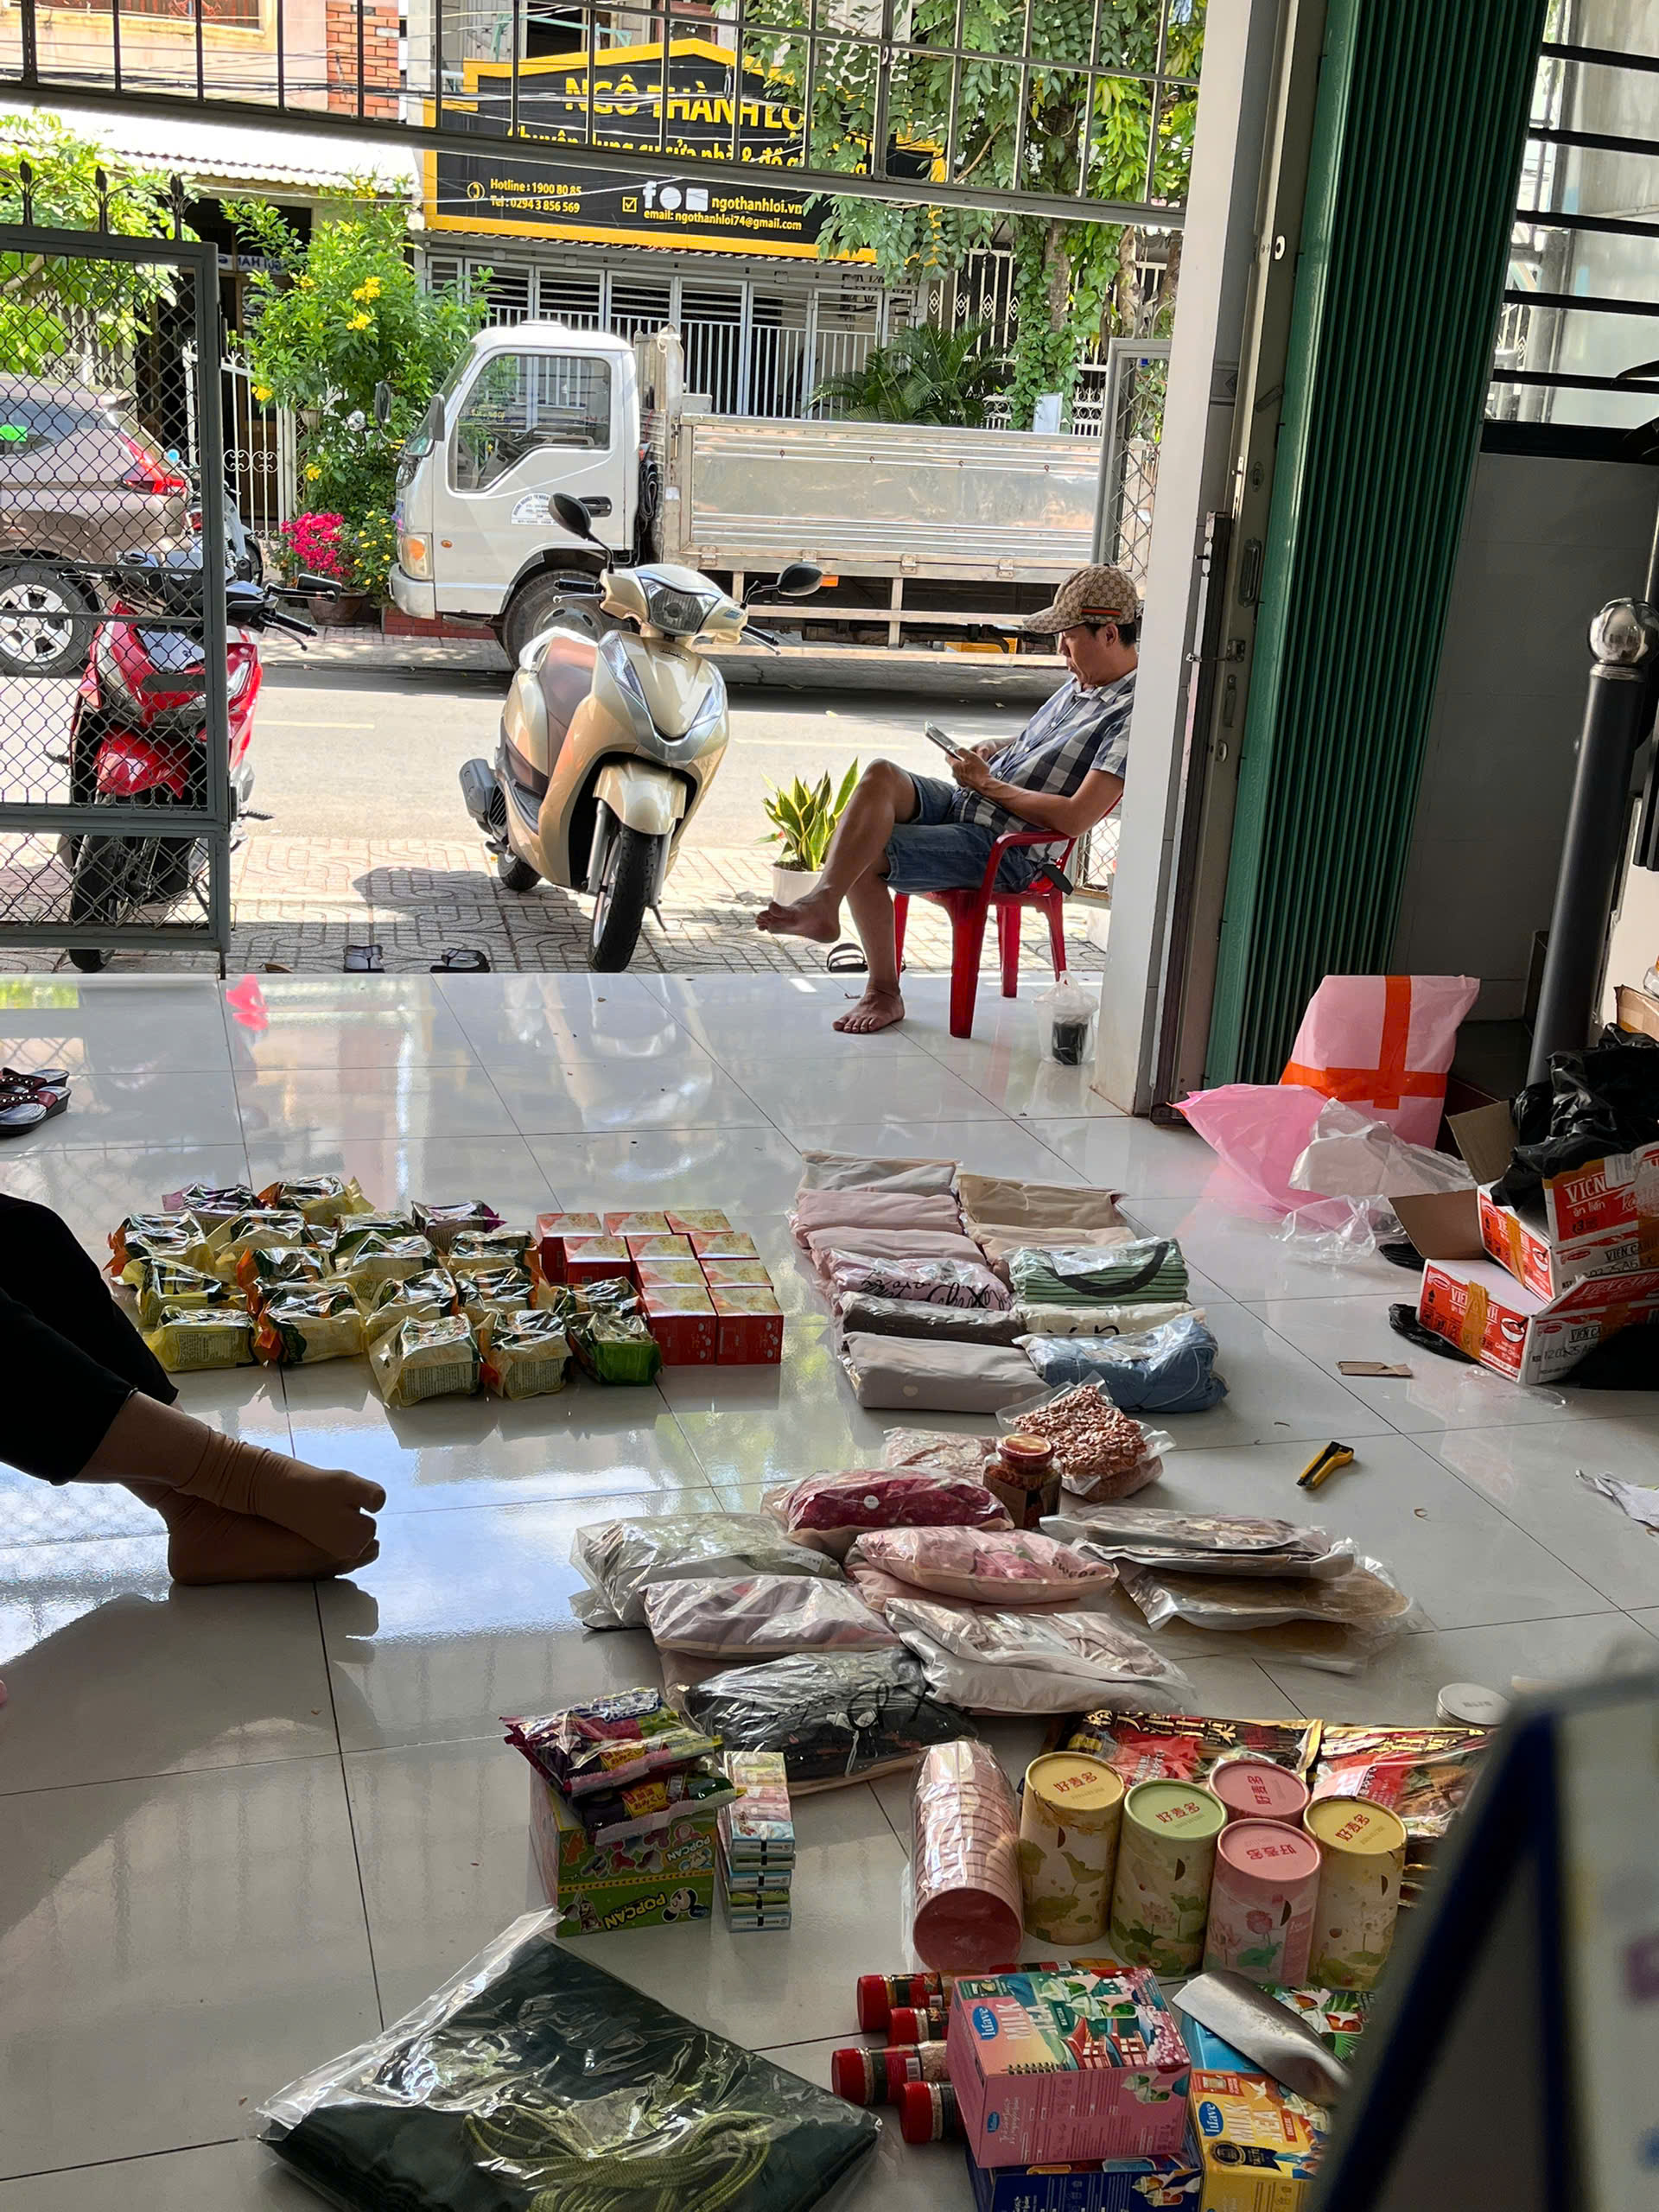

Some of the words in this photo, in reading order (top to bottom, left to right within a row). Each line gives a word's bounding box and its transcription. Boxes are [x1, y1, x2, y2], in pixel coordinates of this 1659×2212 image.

[532, 182, 555, 194] 1900
[556, 184, 569, 195] 80
[536, 200, 542, 210] 3
[543, 200, 561, 213] 856
[563, 201, 581, 213] 569
[711, 196, 803, 215] ngothanhloi.vn
[644, 209, 674, 221] email:
[675, 212, 802, 231] ngothanhloi74@gmail.com
[667, 1834, 711, 1862] POPCAN
[603, 1892, 668, 1930] POPCAN
[995, 2002, 1032, 2040] MILK
[1223, 2101, 1255, 2143] MILK
